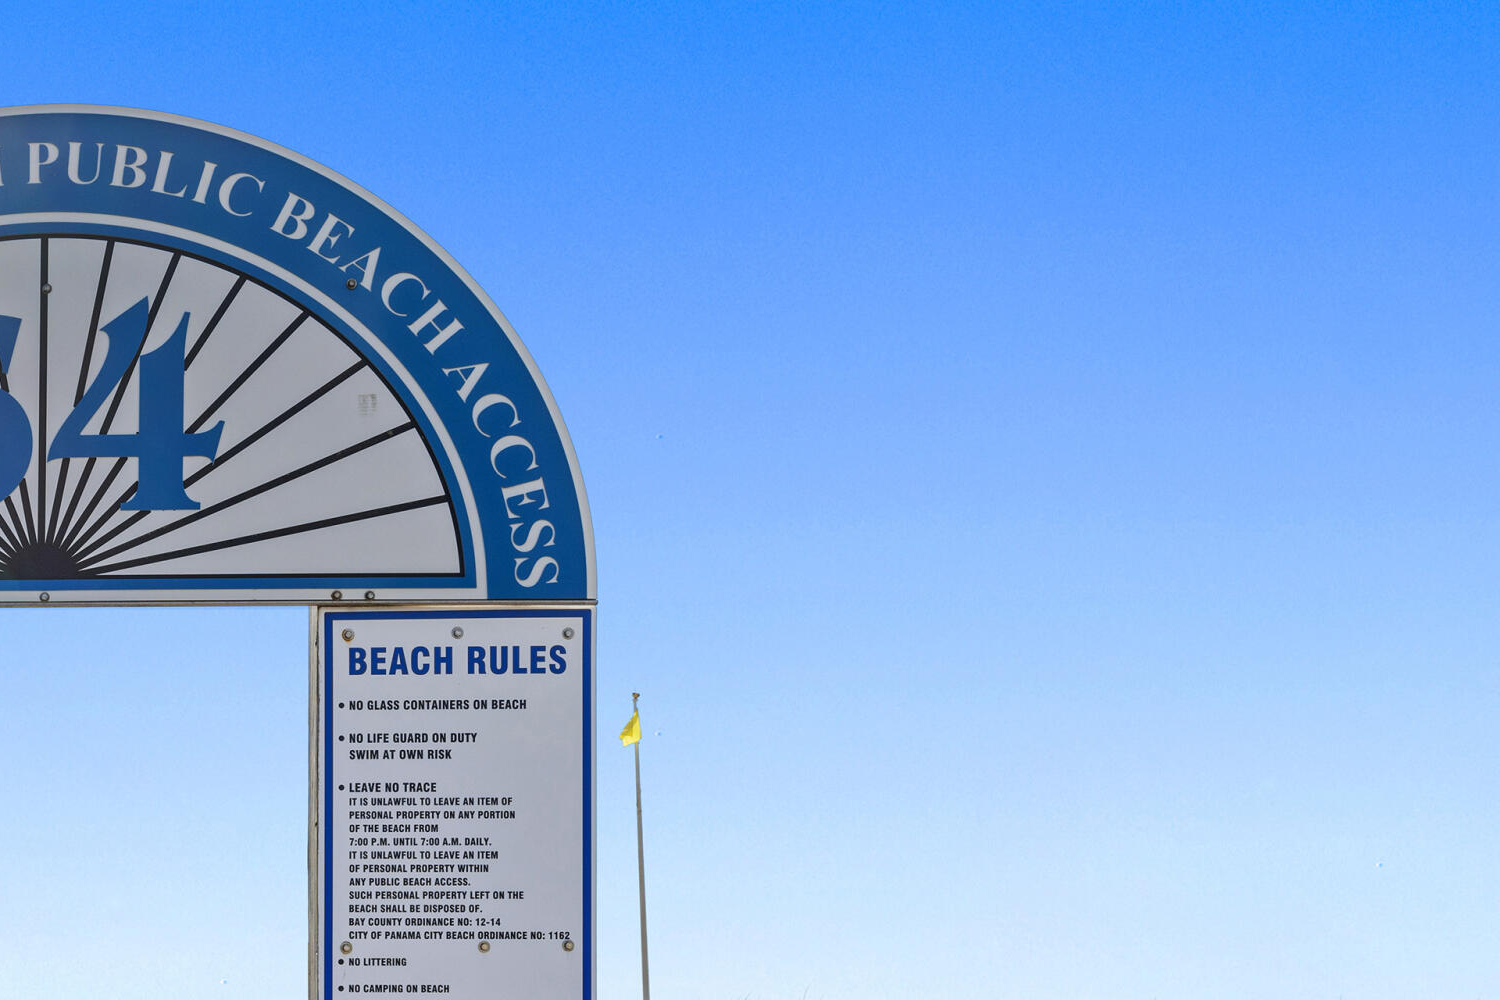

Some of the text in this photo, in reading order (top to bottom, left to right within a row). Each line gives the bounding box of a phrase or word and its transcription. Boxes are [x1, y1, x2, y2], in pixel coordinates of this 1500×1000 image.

[28, 140, 266, 216] PUBLIC
[269, 192, 464, 354] BEACH
[444, 362, 560, 589] ACCESS
[349, 645, 567, 675] BEACH RULES
[349, 699, 526, 710] NO GLASS CONTAINERS ON BEACH
[349, 733, 477, 743] NO LIFE GUARD ON DUTY
[350, 750, 452, 760] SWIM AT OWN RISK
[349, 783, 436, 793] LEAVE NO TRACE
[350, 838, 492, 846] 7:00 P.M. UNTIL 7:00 A.M. DAILY.
[349, 918, 500, 926] BAY COUNTY ORDINANCE NO: 12-14
[349, 931, 570, 940] CITY OF PANAMA CITY BEACH ORDINANCE NO: 1162
[349, 958, 407, 966] NO LITTERING
[349, 985, 449, 993] NO CAMPING ON BEACH
